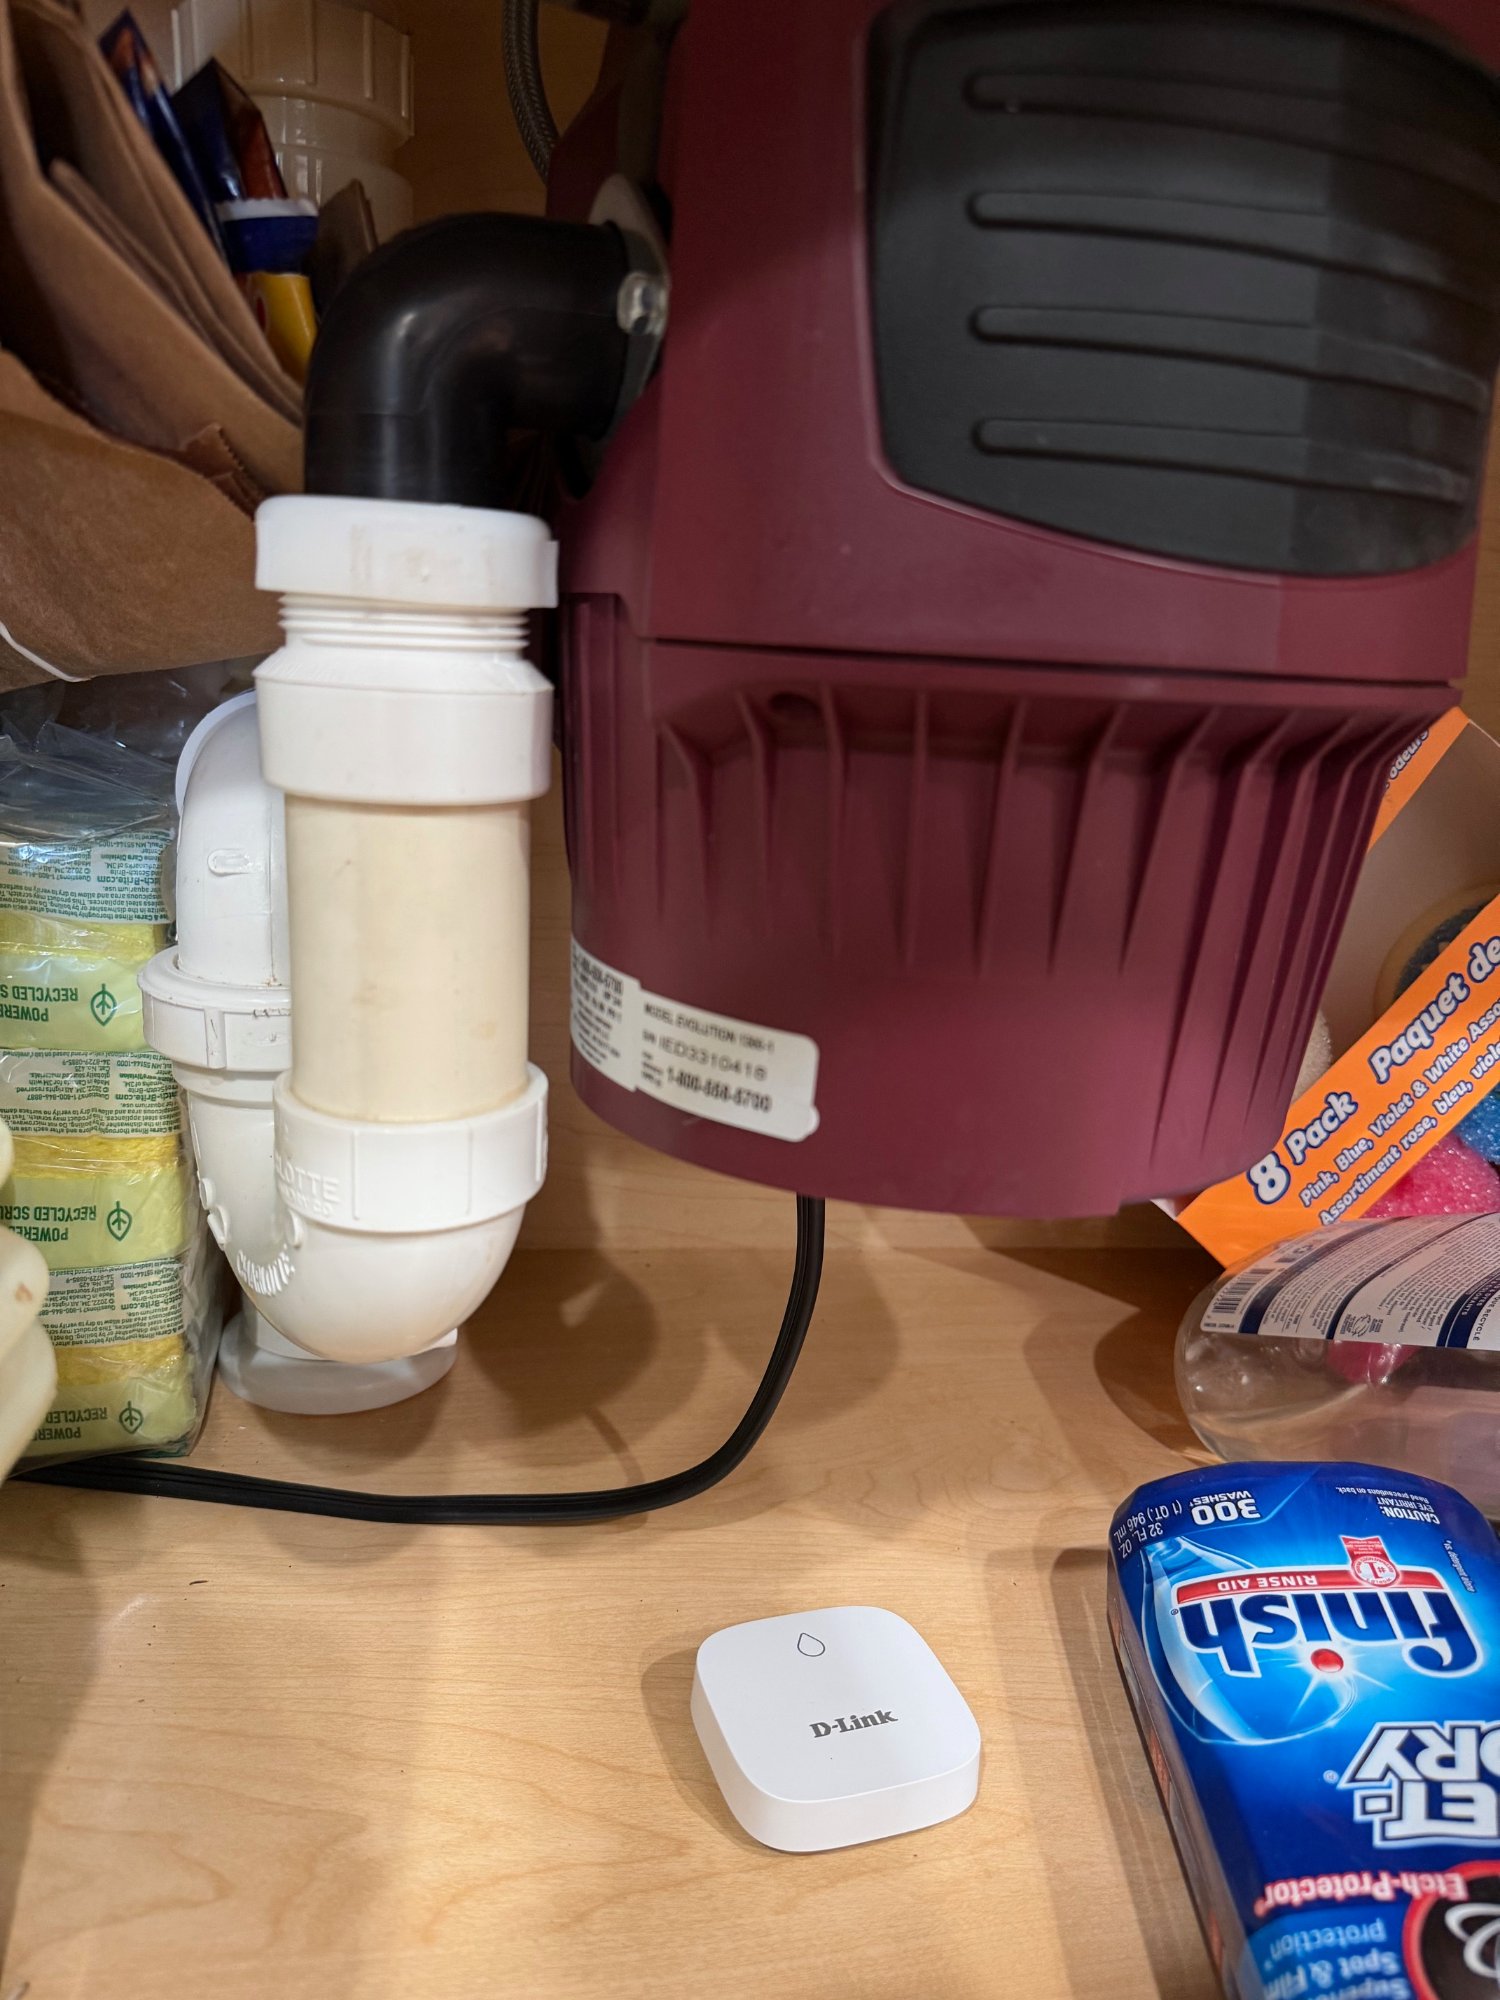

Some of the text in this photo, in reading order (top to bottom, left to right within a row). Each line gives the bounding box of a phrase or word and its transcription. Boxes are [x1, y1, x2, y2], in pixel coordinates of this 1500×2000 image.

[48, 894, 71, 902] product
[49, 901, 71, 909] boiling.
[79, 911, 114, 919] thoroughly
[12, 986, 78, 1001] RECYCLED
[1247, 1151, 1291, 1205] 8
[1283, 1091, 1358, 1166] Pack
[1369, 972, 1470, 1085] Paquet
[1468, 935, 1500, 984] de
[1299, 998, 1500, 1208] Pink, Blue, Violet & White Asso
[1318, 1144, 1403, 1226] Assortiment
[1400, 1113, 1438, 1156] rose,
[1431, 1079, 1473, 1117] bleu,
[34, 1206, 96, 1222] RECYCLED
[59, 1321, 77, 1329] verify
[74, 1326, 98, 1334] product
[45, 1407, 107, 1423] RECYCLED
[1335, 1486, 1429, 1504] Read precautions on back.
[1376, 1497, 1434, 1512] EYE IRRITANT
[1114, 1499, 1182, 1543] (1 QT.) 946 mL
[1192, 1499, 1260, 1525] 300
[1380, 1506, 1441, 1525] CAUTION:
[1118, 1521, 1163, 1558] 32 FL. OZ.
[1364, 1561, 1387, 1579] #1
[1218, 1573, 1317, 1592] RINSE AID
[1179, 1590, 1481, 1676] finish
[809, 1709, 899, 1738] D-Link
[1354, 1781, 1500, 1847] ET-
[1308, 1960, 1334, 1990] &
[1339, 1948, 1399, 1984] Spot
